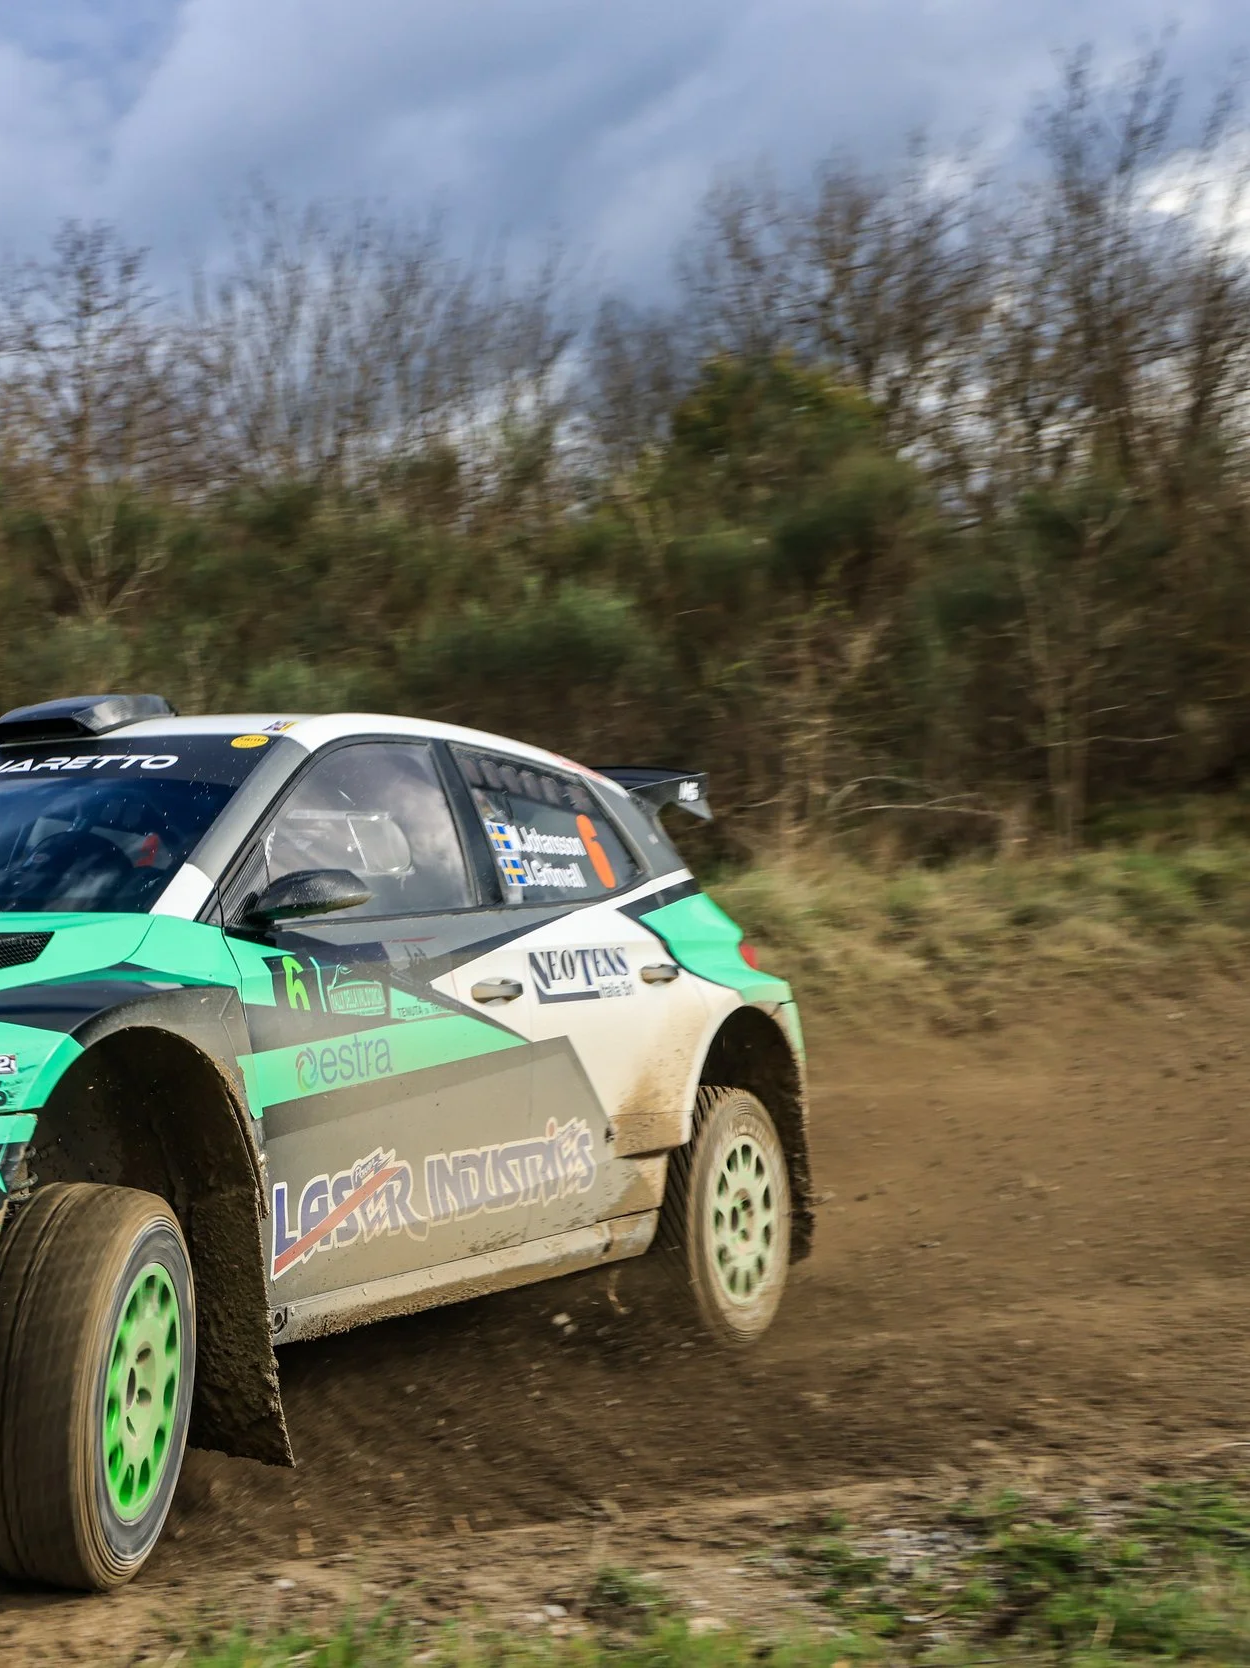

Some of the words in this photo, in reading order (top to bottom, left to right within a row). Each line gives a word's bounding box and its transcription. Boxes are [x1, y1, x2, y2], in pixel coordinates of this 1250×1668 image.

[576, 814, 616, 888] 6
[528, 946, 629, 989] NEOTENS
[319, 1034, 393, 1084] estra
[272, 1150, 428, 1278] LASER
